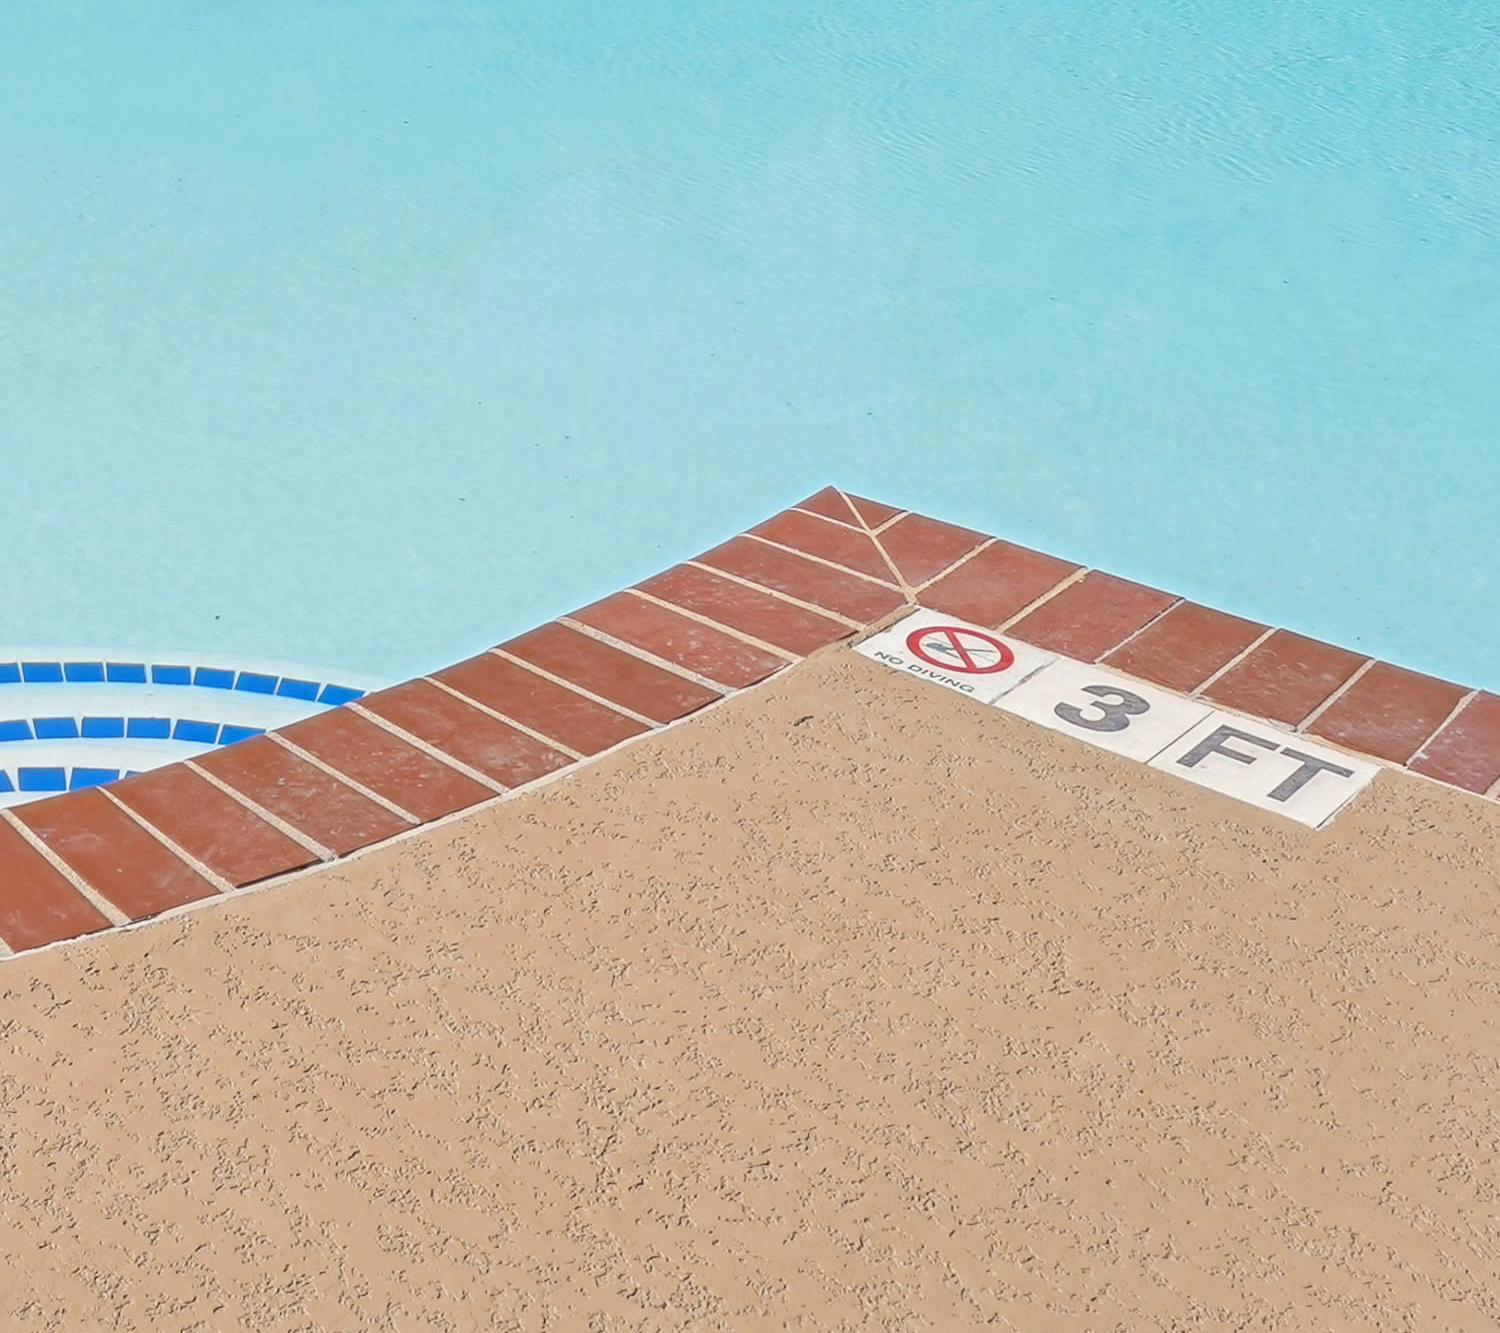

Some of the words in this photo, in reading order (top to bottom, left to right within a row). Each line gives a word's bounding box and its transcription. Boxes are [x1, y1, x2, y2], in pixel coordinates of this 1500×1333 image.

[874, 651, 904, 665] NO
[907, 664, 976, 693] DIVING
[1053, 684, 1151, 733] 3
[1177, 723, 1354, 803] FT
